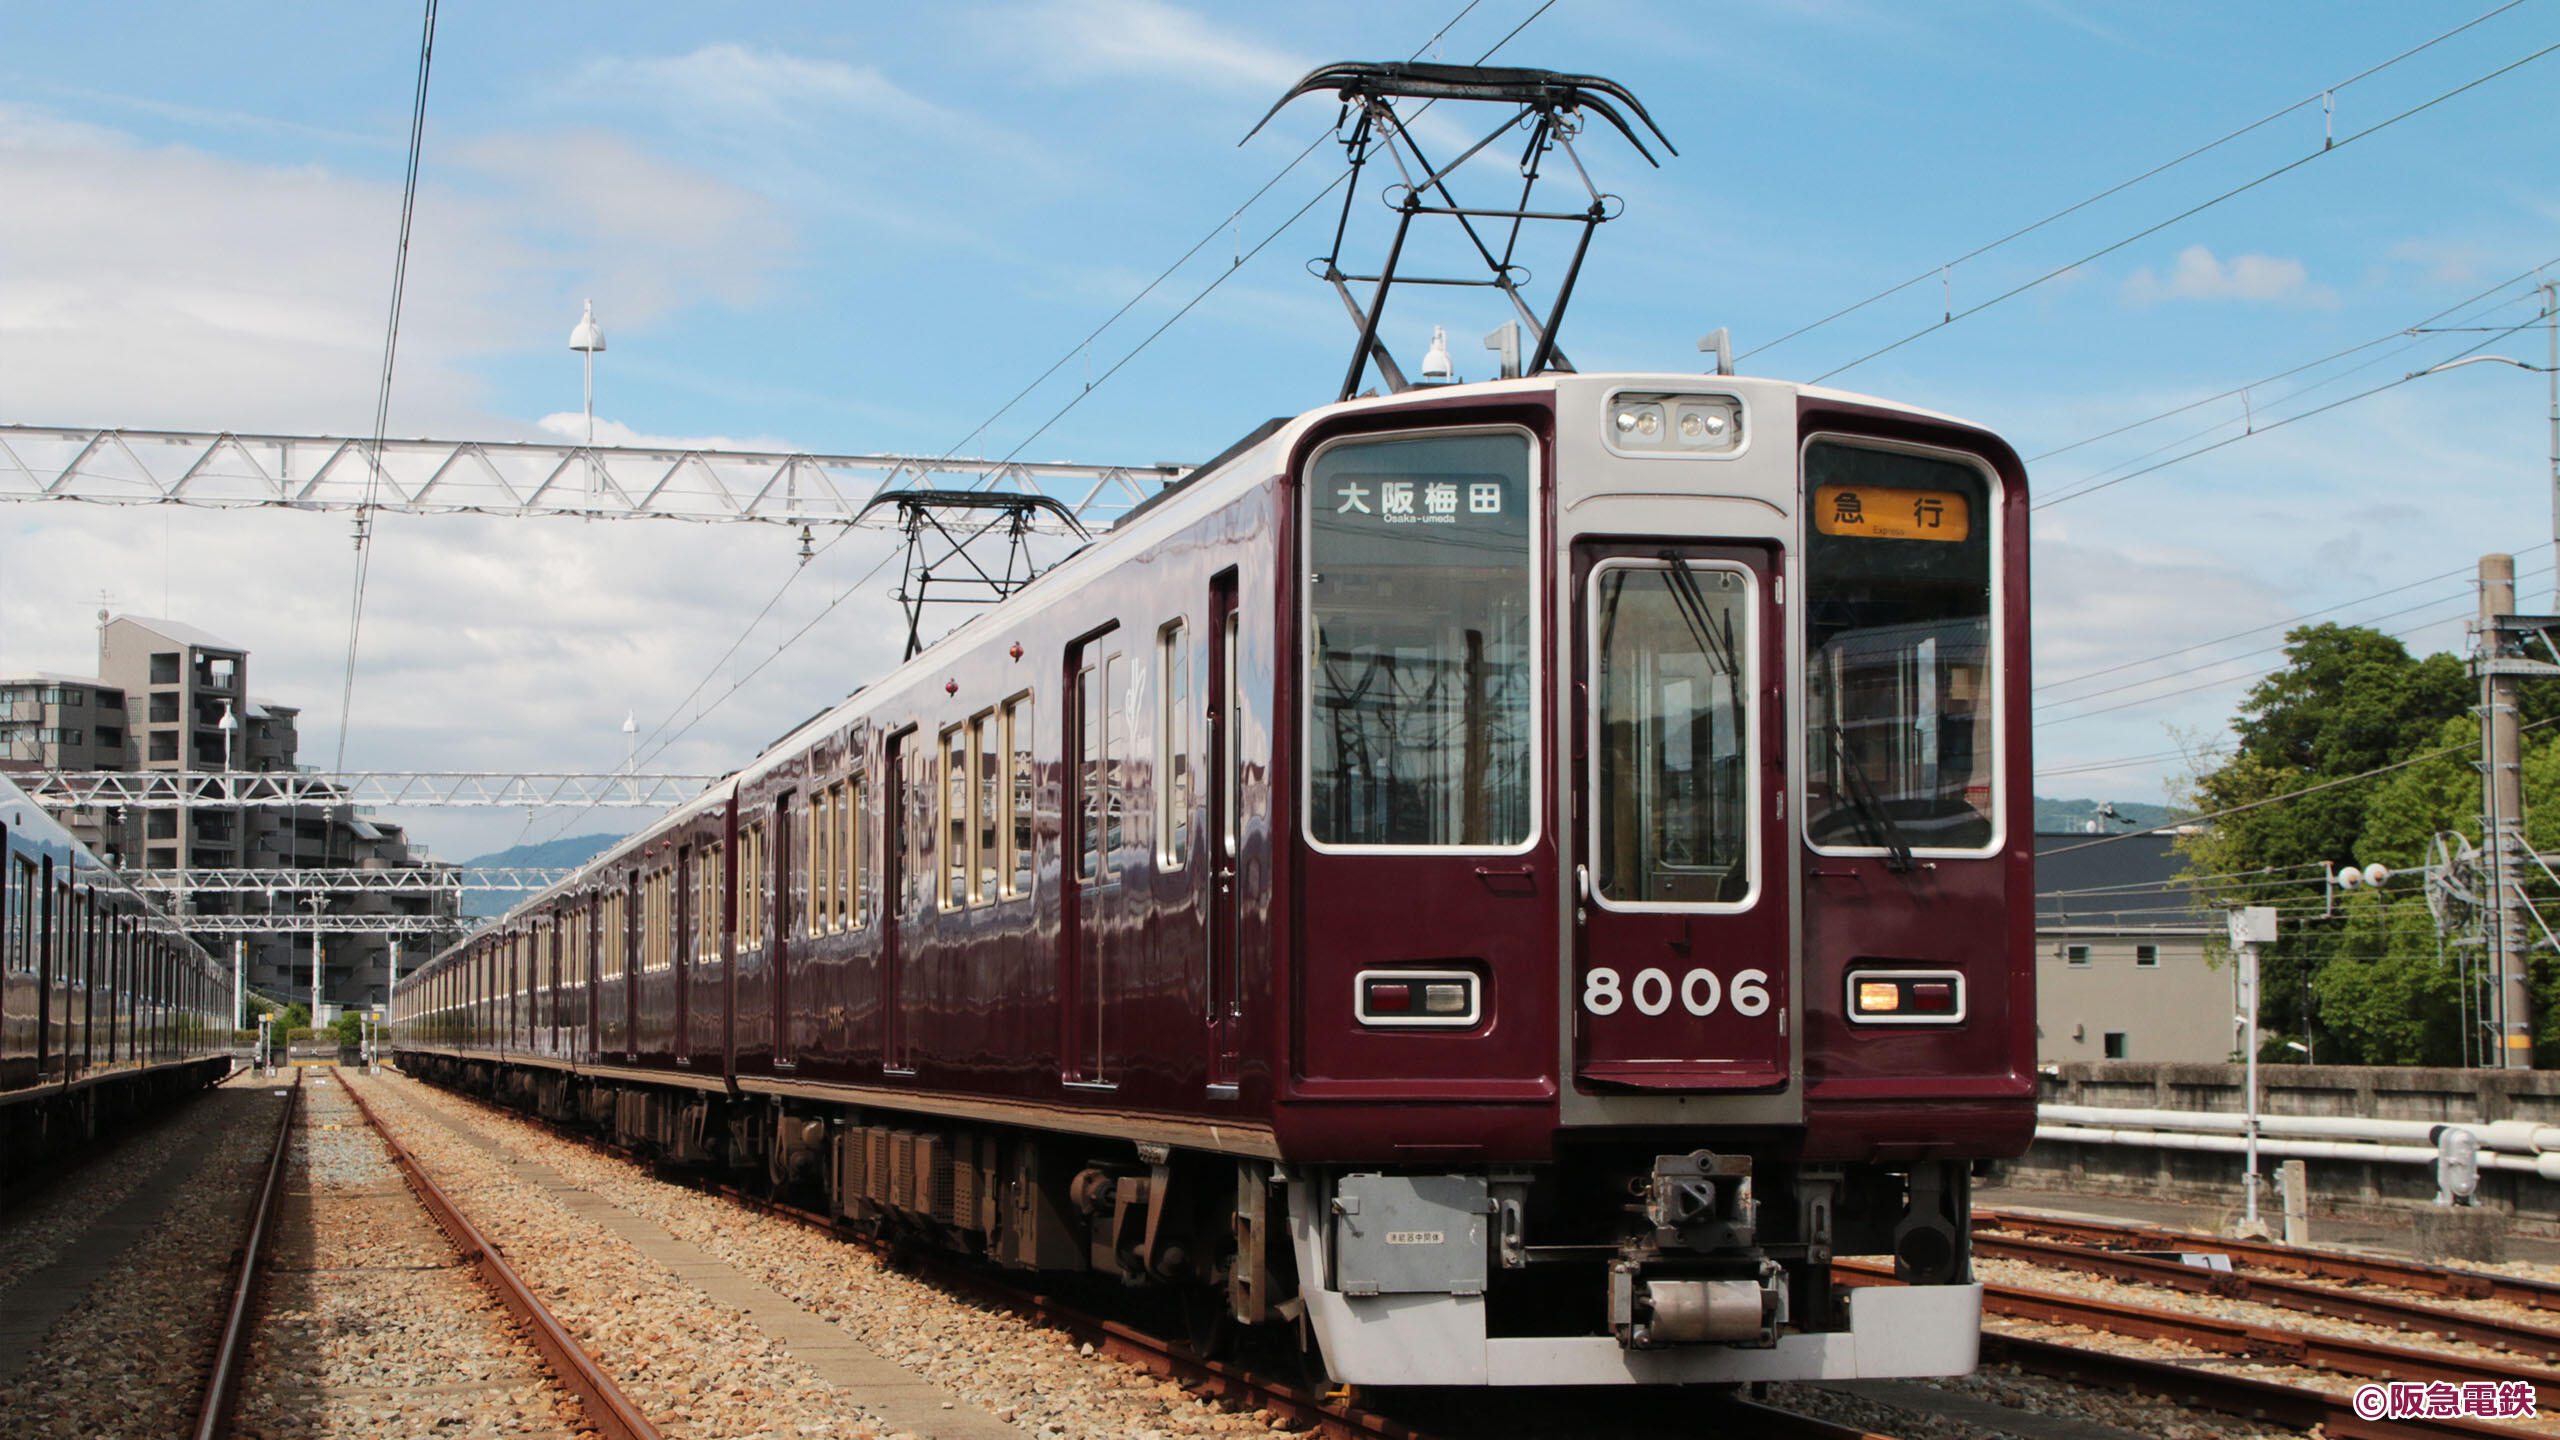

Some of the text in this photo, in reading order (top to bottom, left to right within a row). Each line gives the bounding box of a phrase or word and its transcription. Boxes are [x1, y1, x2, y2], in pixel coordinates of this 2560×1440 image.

[1337, 482, 1501, 514] 大阪梅田
[1833, 492, 1944, 529] 急行
[1383, 513, 1456, 524] Osaka-umeda
[1583, 967, 1770, 1017] 8006
